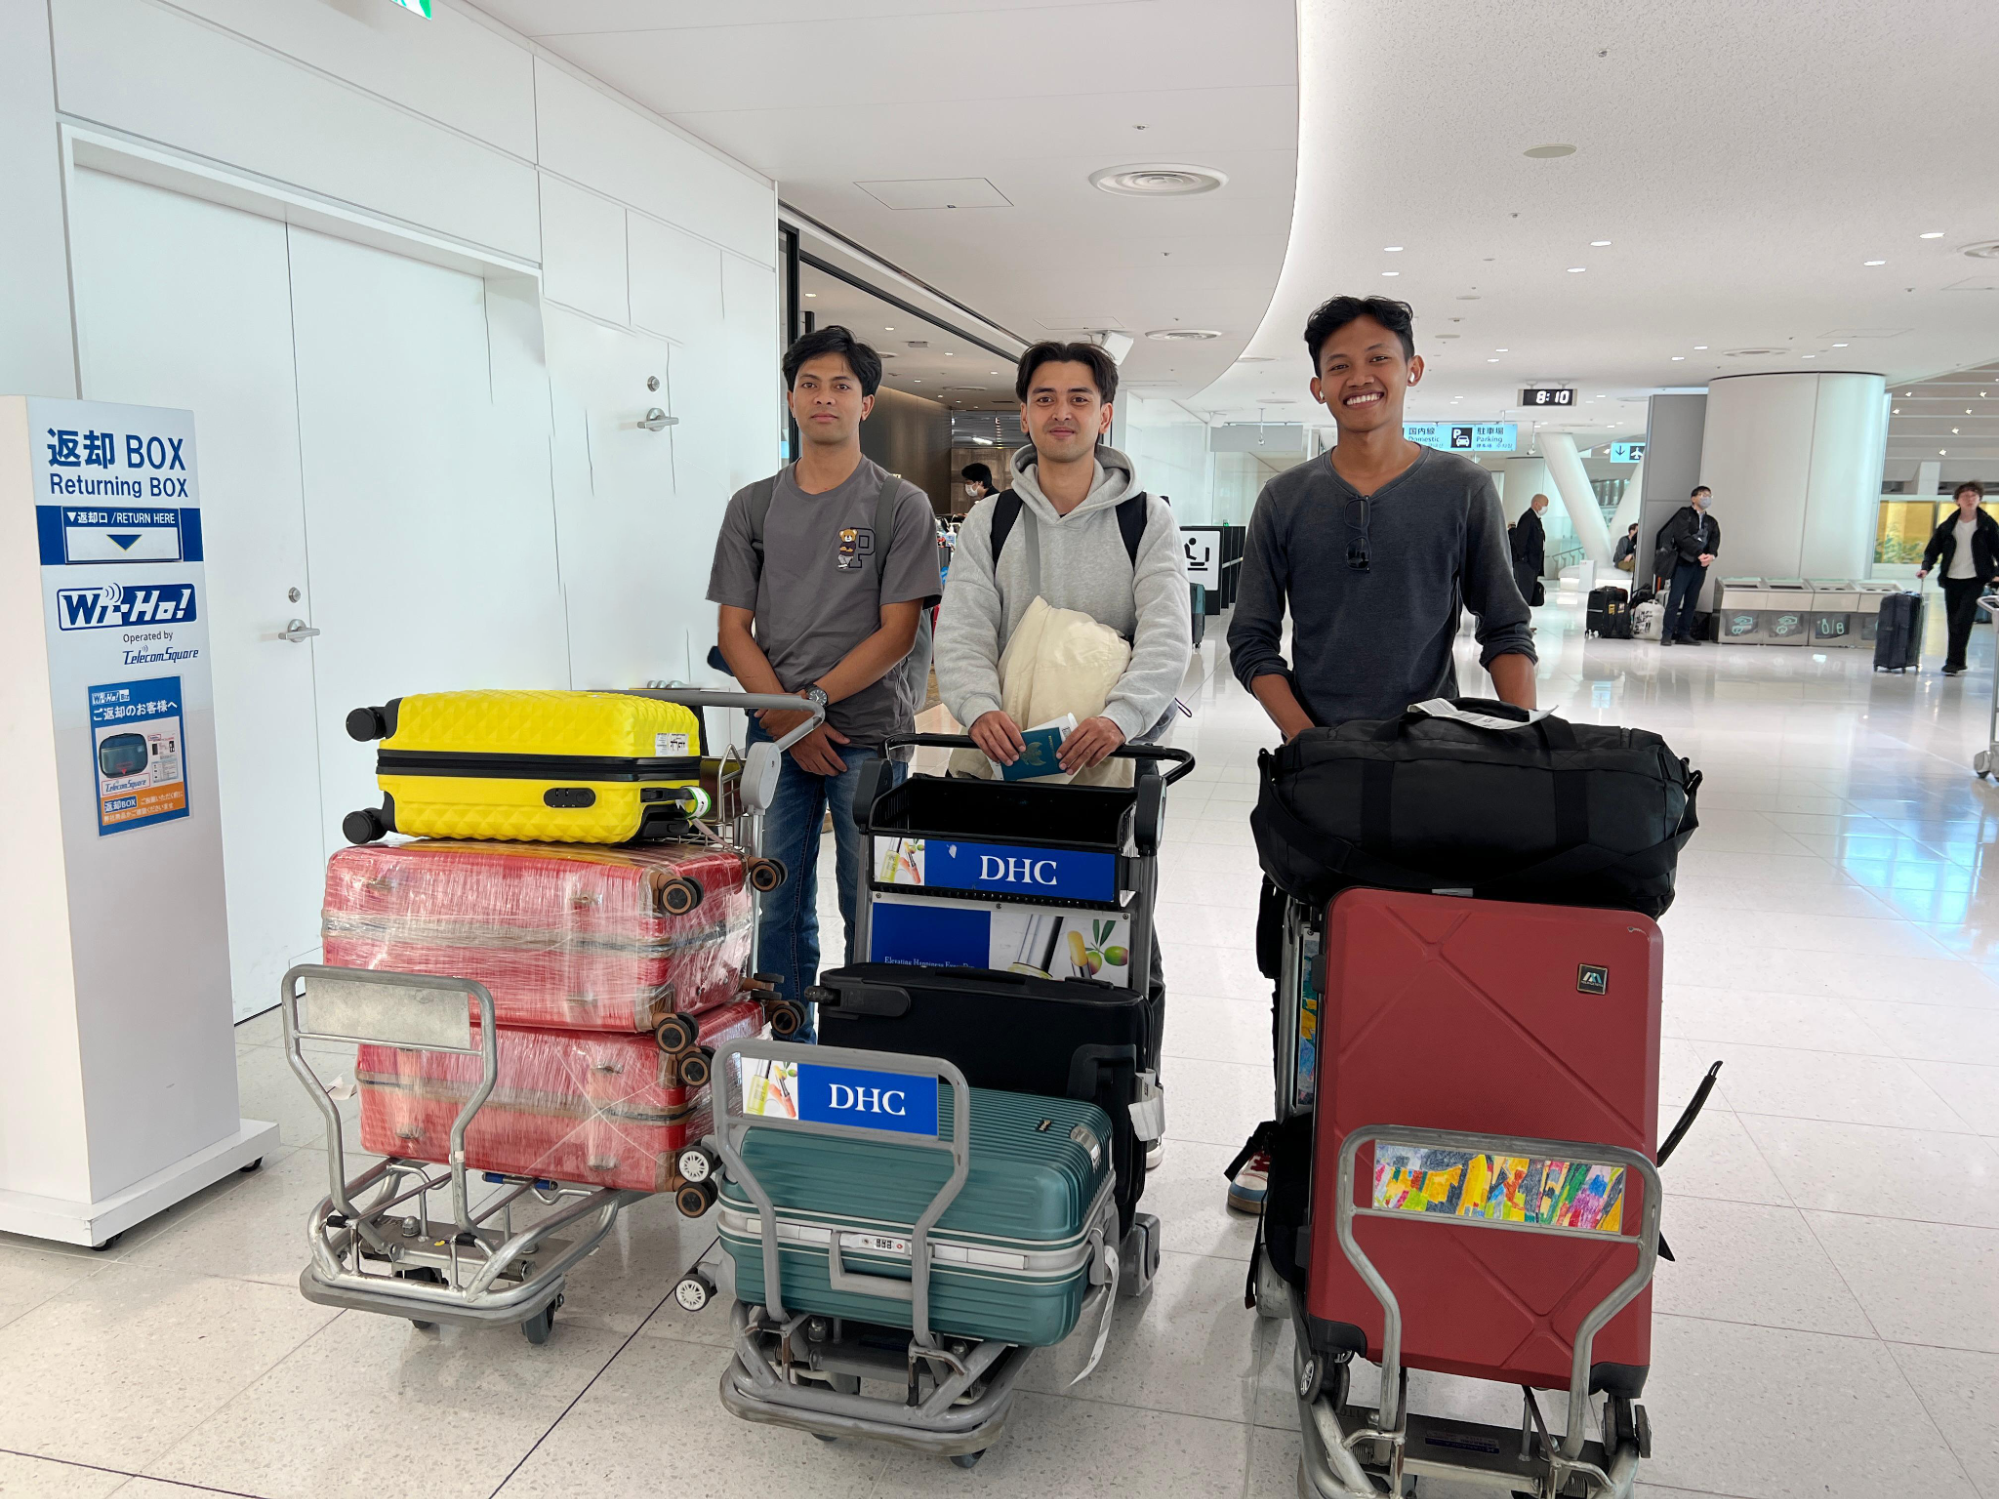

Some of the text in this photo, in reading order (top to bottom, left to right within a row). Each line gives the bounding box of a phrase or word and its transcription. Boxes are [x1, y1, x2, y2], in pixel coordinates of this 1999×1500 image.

[1536, 391, 1570, 404] 8:10
[47, 428, 187, 471] 返却 BOX
[49, 473, 189, 498] Returning BOX
[77, 511, 108, 524] 返却口
[153, 512, 176, 524] HERE
[60, 586, 192, 626] Wi-Ho!
[123, 630, 174, 643] Operated by
[93, 691, 121, 705] Wi-Ho!
[93, 699, 178, 721] ご返却のお客様へ
[979, 855, 1058, 886] DHC
[828, 1083, 906, 1116] DHC
